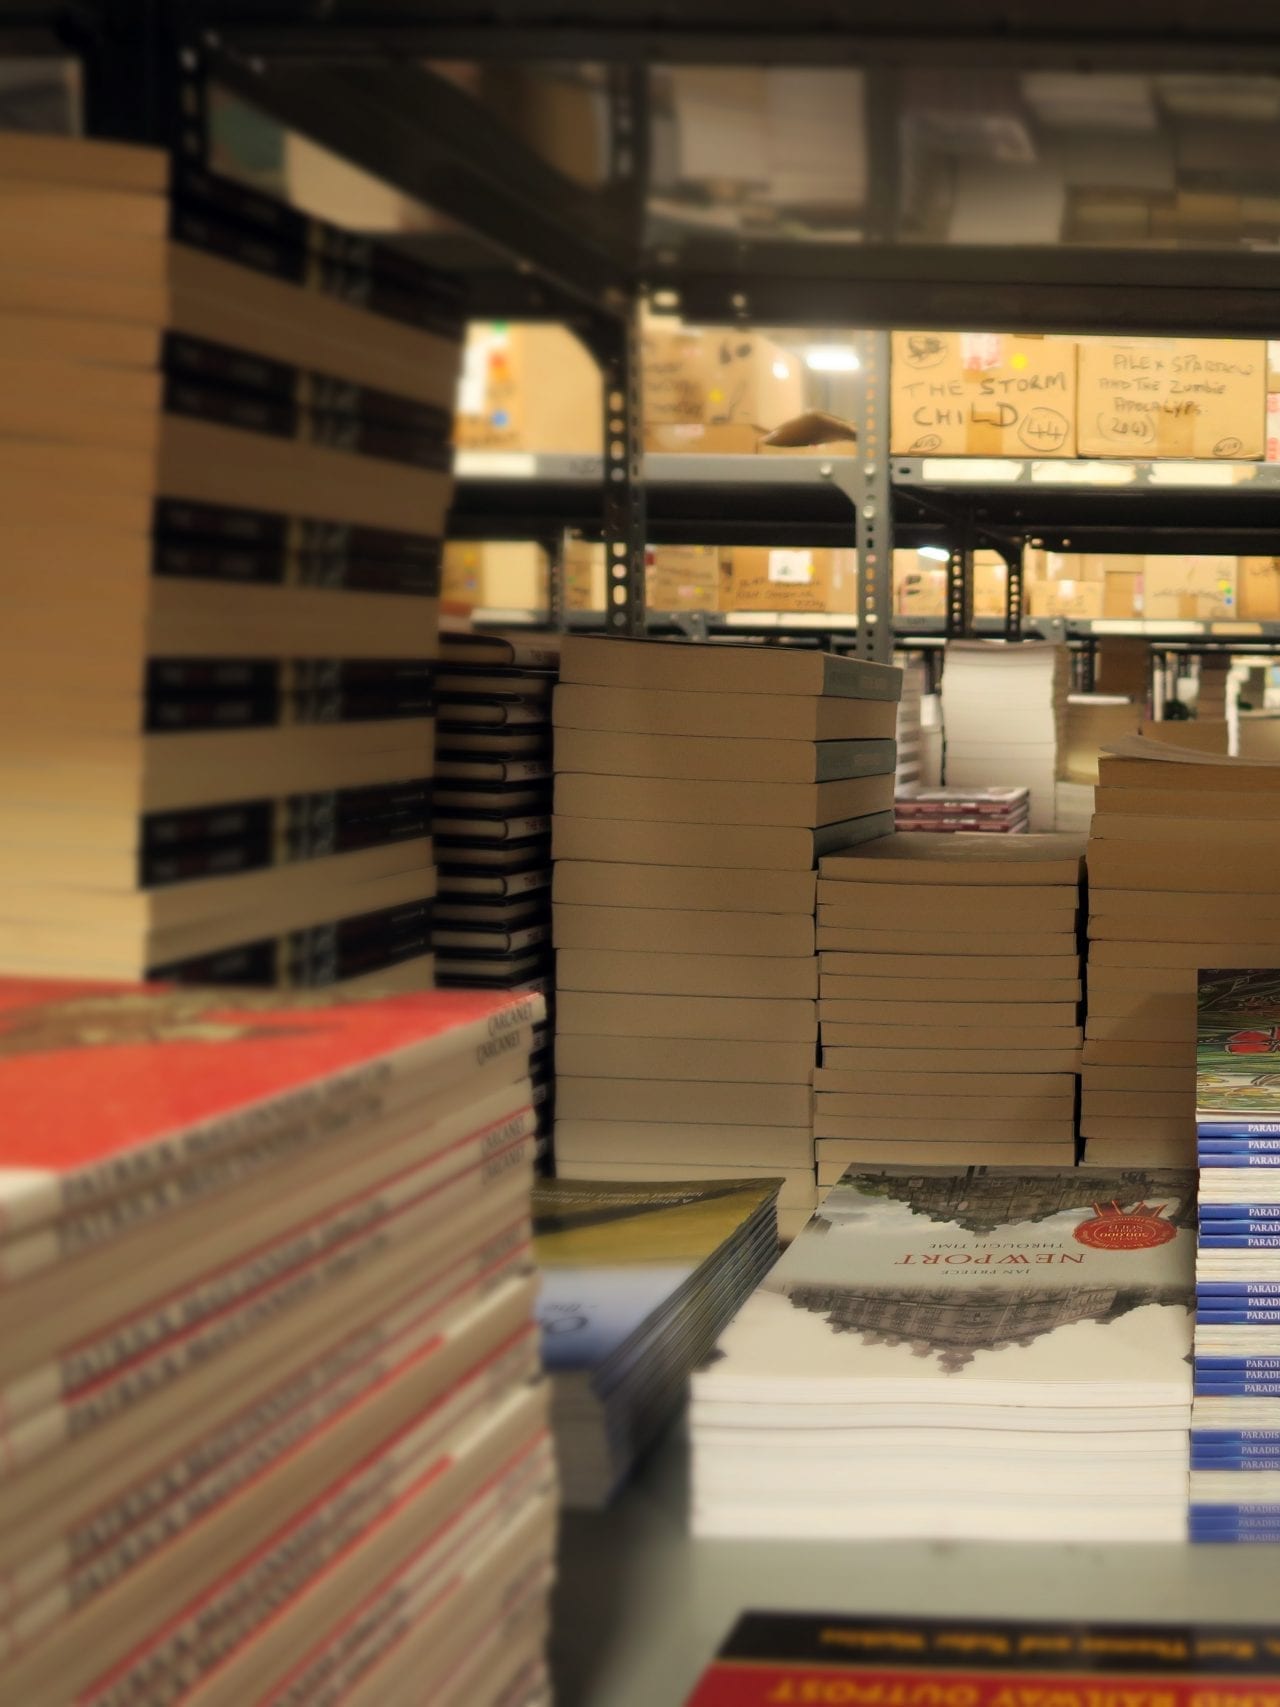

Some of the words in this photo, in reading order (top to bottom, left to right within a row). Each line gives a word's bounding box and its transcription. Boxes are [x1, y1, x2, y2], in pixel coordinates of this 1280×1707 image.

[902, 379, 964, 396] THE
[979, 372, 1067, 396] STORM
[912, 402, 1018, 428] CHILD
[893, 1253, 1087, 1265] NEWPORT
[772, 1677, 980, 1704] OUTPOST
[996, 1684, 1176, 1707] RAILWAY
